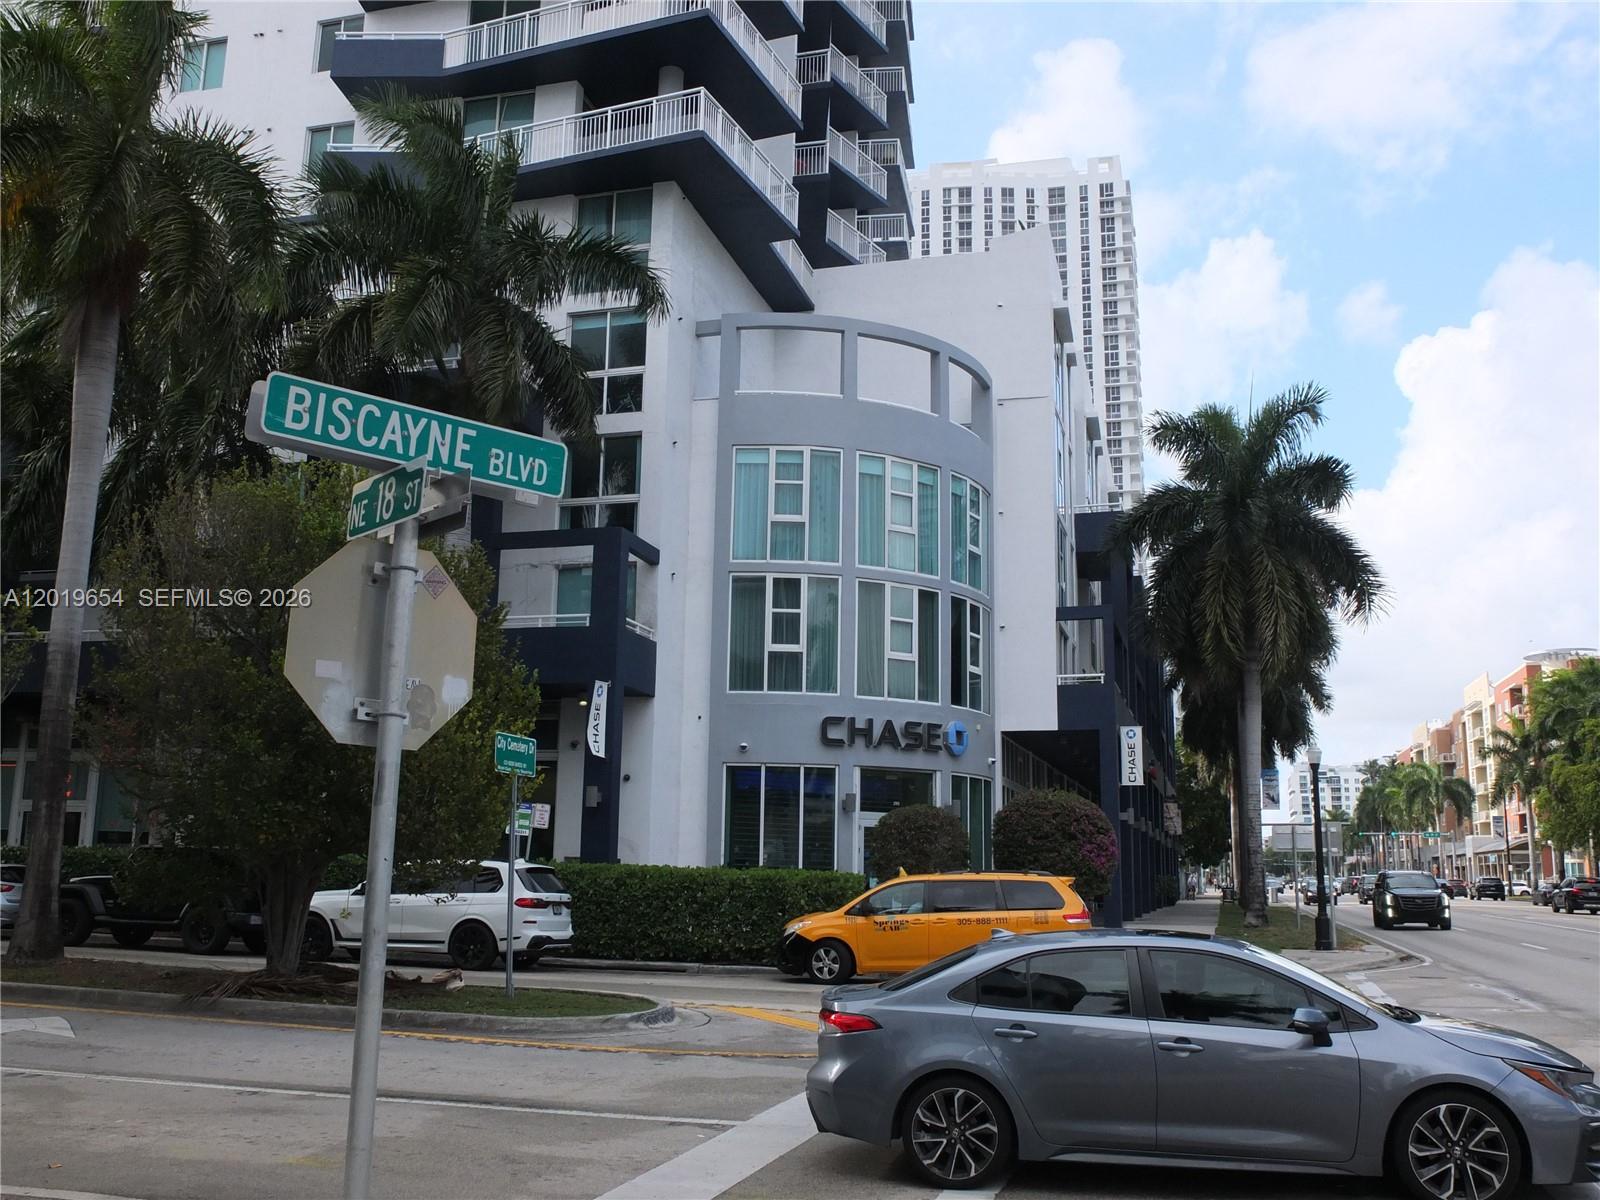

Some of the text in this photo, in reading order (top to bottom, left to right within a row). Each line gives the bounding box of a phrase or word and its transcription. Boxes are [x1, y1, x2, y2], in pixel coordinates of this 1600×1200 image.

[284, 384, 548, 486] BISCAYNE BLVD
[350, 476, 421, 530] NE 18 ST
[497, 735, 535, 755] City Cemetery Dr
[592, 703, 601, 753] CHASE
[820, 715, 945, 752] CHASE
[1127, 742, 1137, 783] CHASE
[873, 919, 909, 928] Springs
[956, 917, 1008, 926] 305-888-1111
